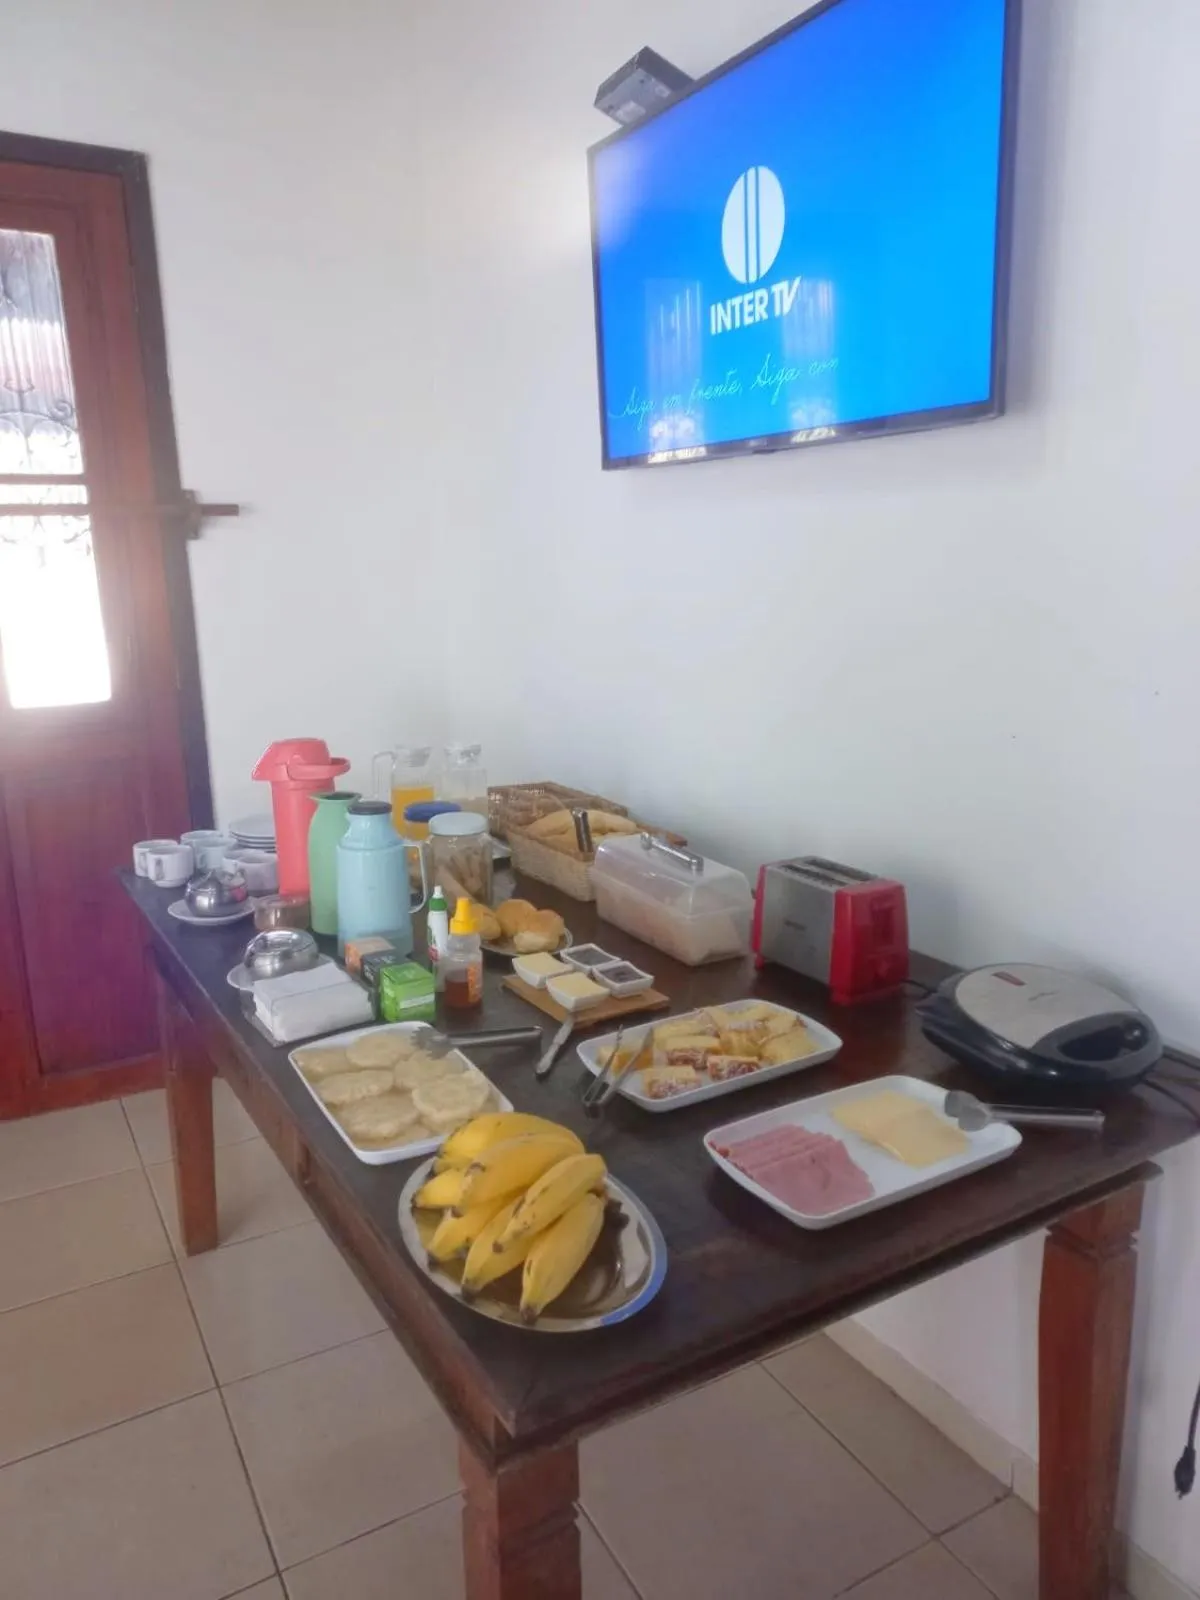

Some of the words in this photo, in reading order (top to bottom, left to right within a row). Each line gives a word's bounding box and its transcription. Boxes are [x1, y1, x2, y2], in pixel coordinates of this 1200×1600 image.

[709, 288, 769, 336] INTER
[771, 276, 801, 317] TV
[750, 353, 800, 406] Siga
